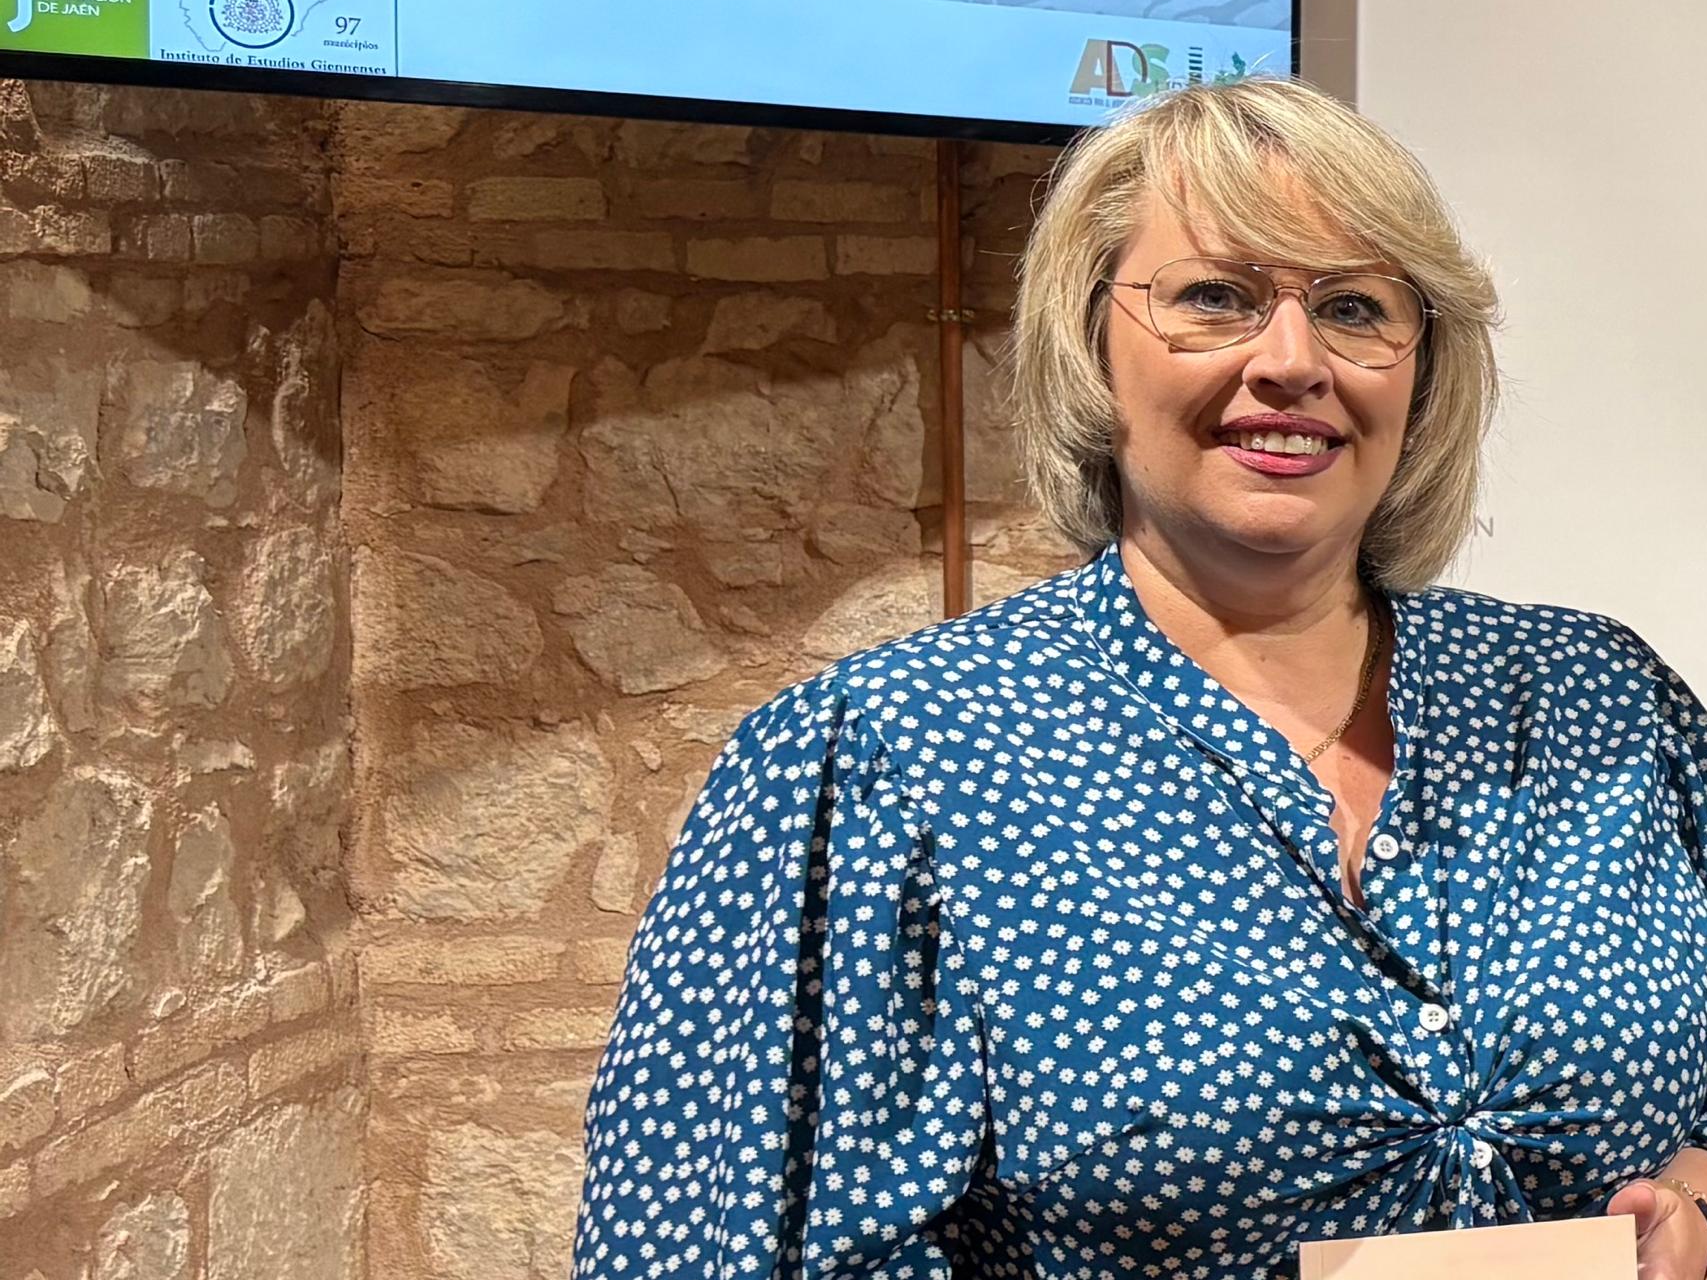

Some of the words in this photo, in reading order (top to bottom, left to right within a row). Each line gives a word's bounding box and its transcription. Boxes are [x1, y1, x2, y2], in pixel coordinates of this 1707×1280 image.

[38, 1, 58, 13] DE
[61, 4, 100, 16] JAÉN
[335, 16, 361, 35] 97
[160, 48, 220, 63] Instituto
[226, 54, 242, 64] de
[248, 55, 305, 69] Estudios
[311, 59, 387, 74] Giennenses
